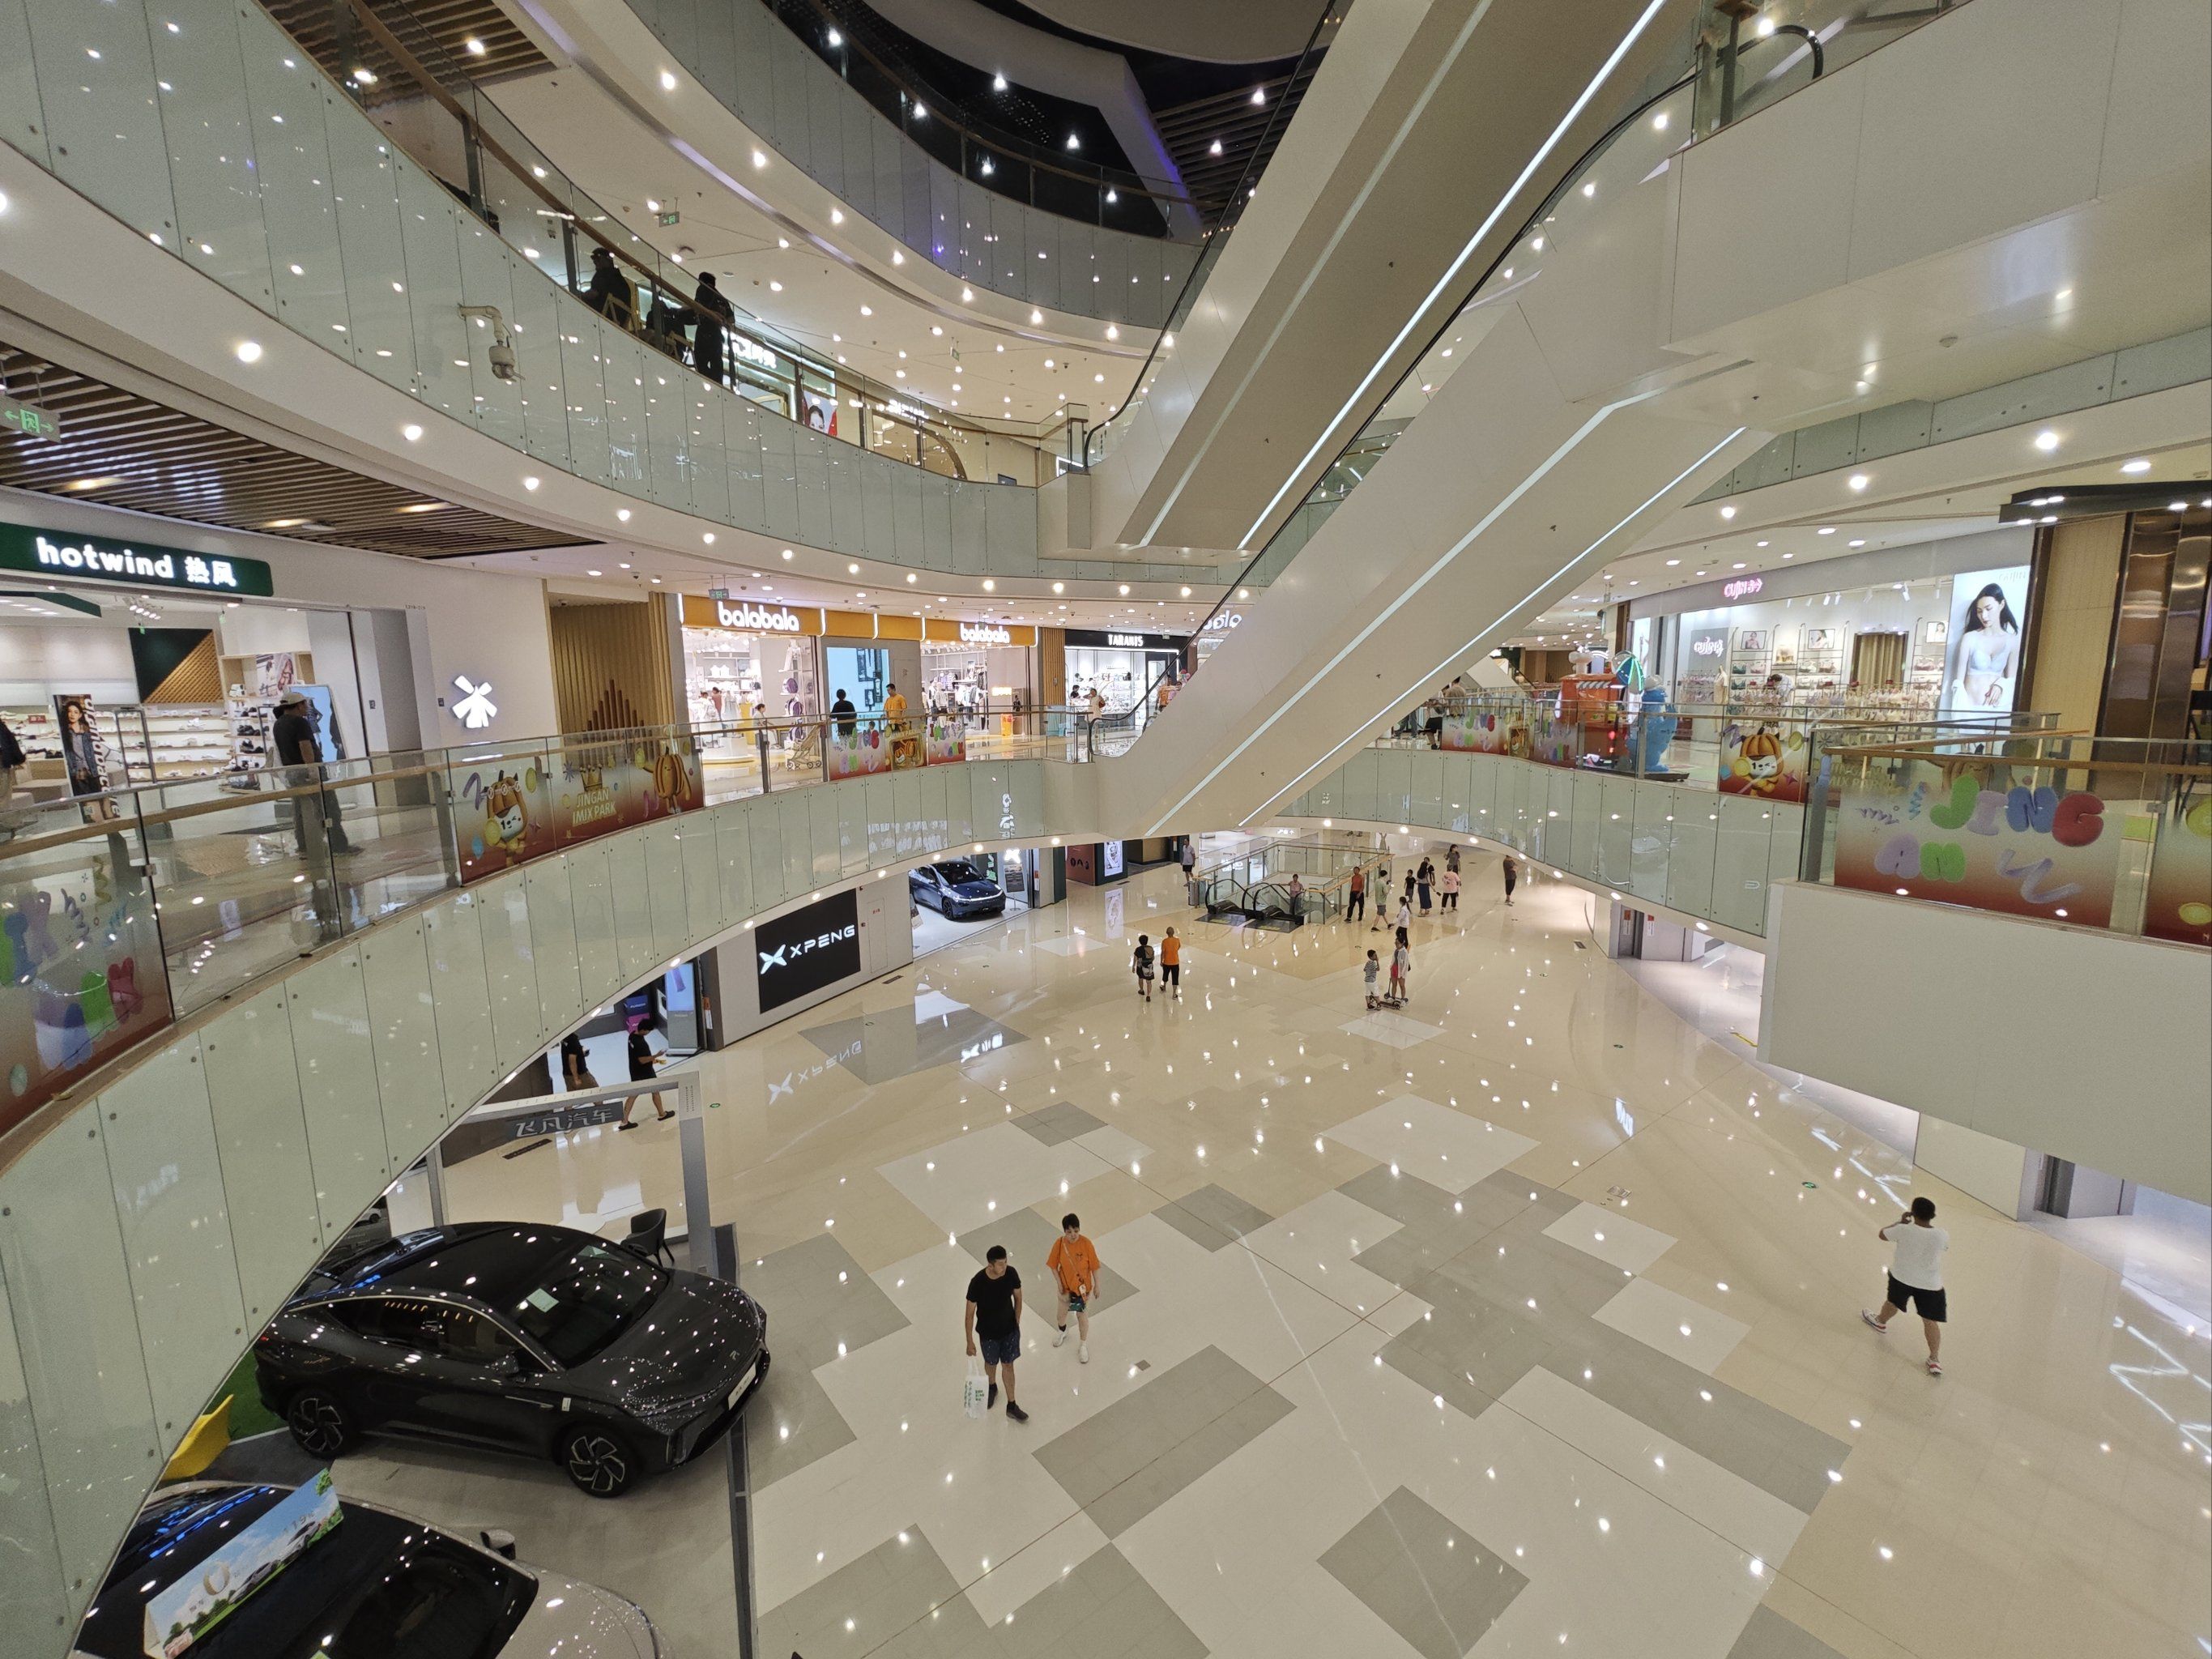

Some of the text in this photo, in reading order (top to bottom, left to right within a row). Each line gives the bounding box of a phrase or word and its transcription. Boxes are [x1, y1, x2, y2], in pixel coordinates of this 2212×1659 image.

[36, 536, 237, 587] hotwind 热风
[717, 600, 799, 631] balabala
[960, 622, 1010, 644] balabala
[577, 787, 610, 808] JINGAN
[1929, 774, 2104, 847] JING
[572, 802, 616, 826] IMIX PARK
[790, 924, 855, 958] XPENG
[516, 1109, 613, 1137] 飞凡汽车
